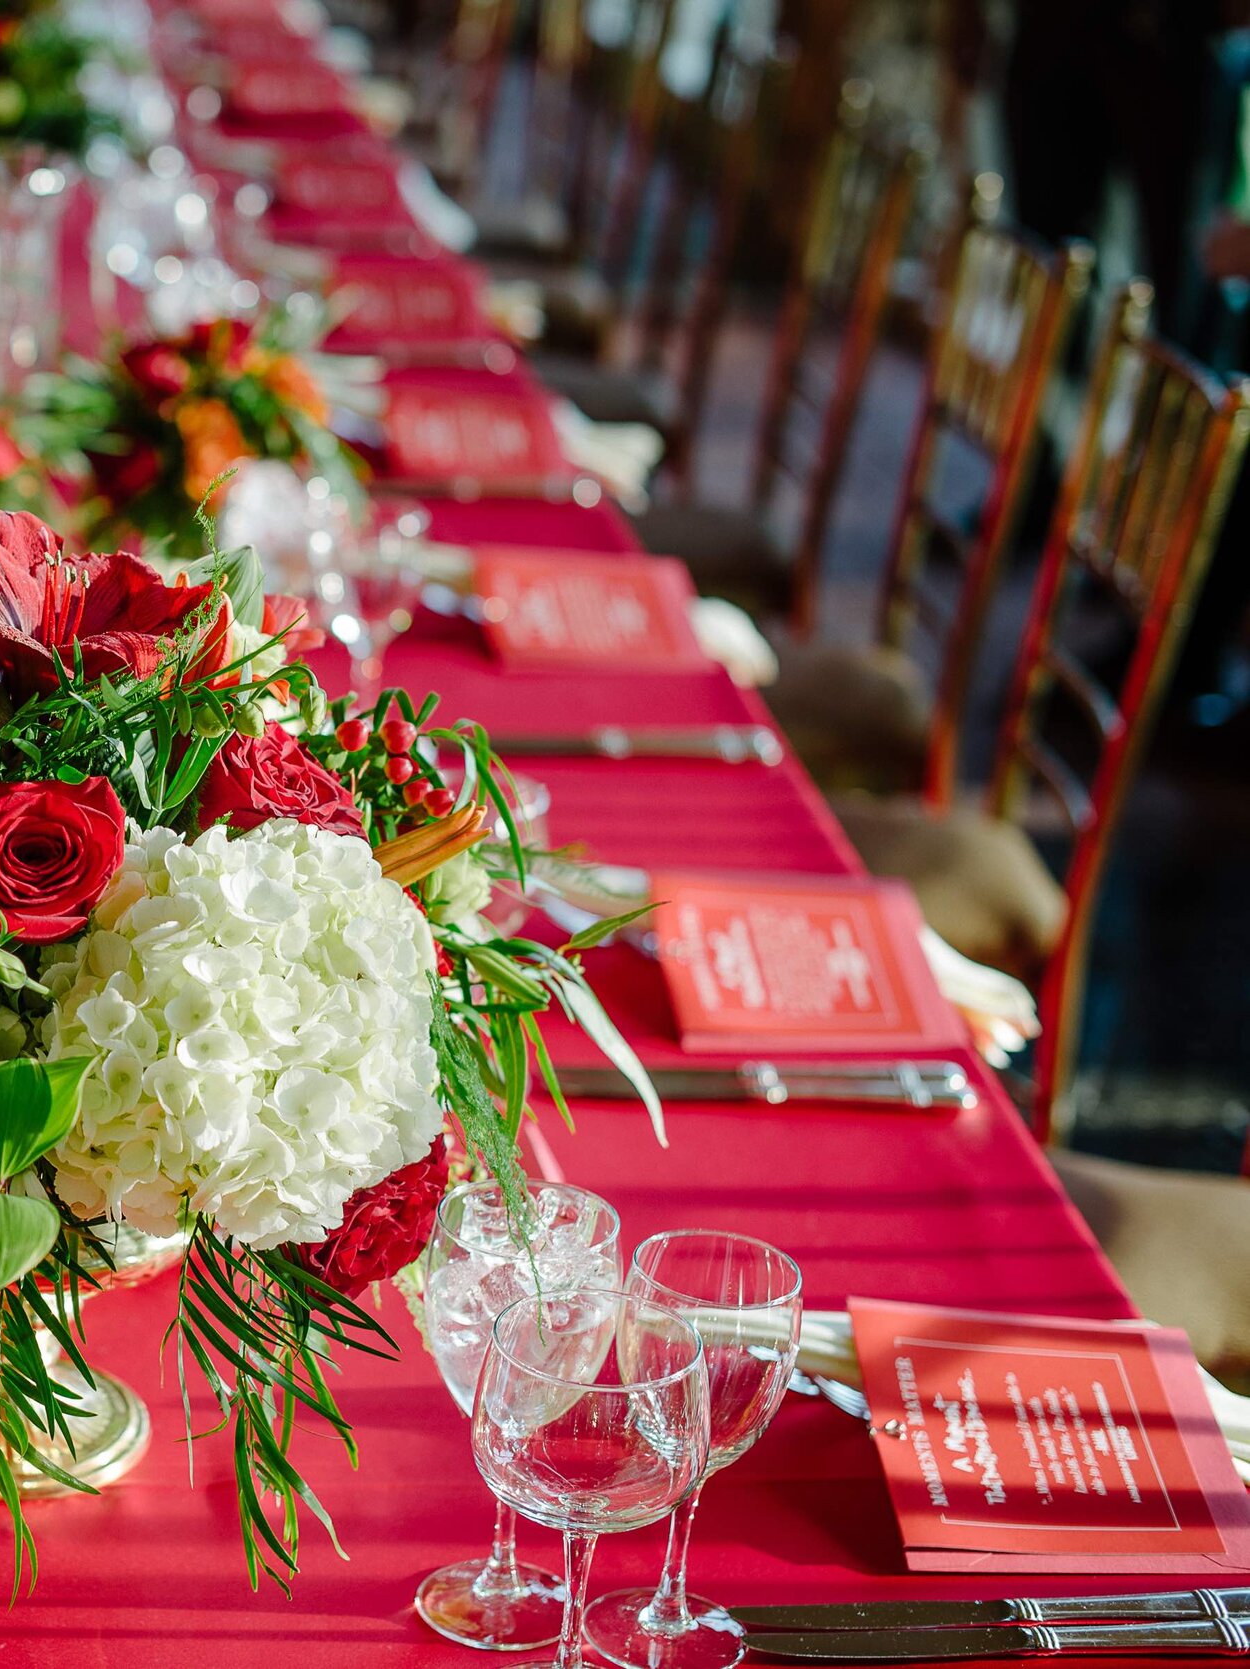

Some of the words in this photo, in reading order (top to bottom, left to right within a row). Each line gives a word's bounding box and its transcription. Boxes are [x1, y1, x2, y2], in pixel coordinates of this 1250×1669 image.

[894, 1356, 923, 1425] MATTER
[907, 1429, 950, 1507] MOMENTS
[951, 1456, 975, 1473] A
